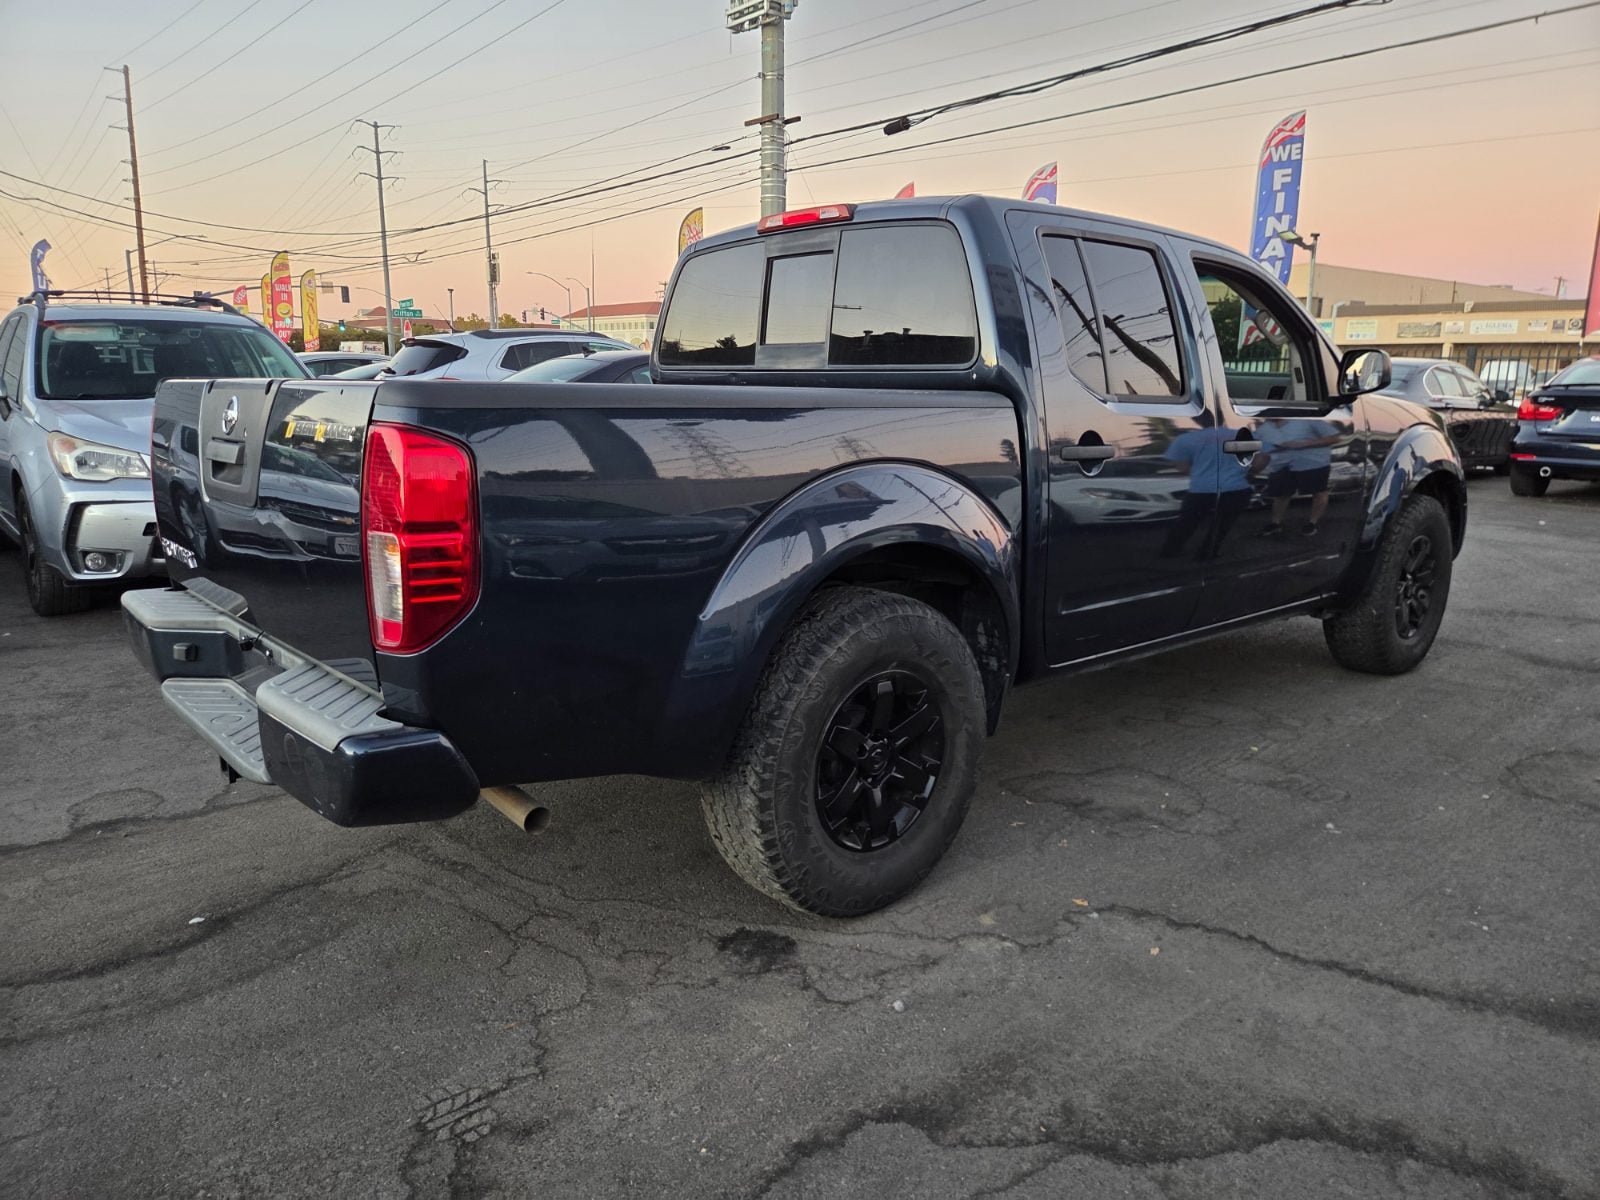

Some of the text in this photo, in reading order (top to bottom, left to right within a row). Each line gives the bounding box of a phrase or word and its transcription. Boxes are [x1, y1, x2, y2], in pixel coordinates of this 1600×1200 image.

[1271, 143, 1301, 162] WE
[274, 283, 292, 292] WALK
[281, 293, 288, 301] IN
[275, 320, 294, 329] DRIVE
[278, 330, 291, 338] OUT
